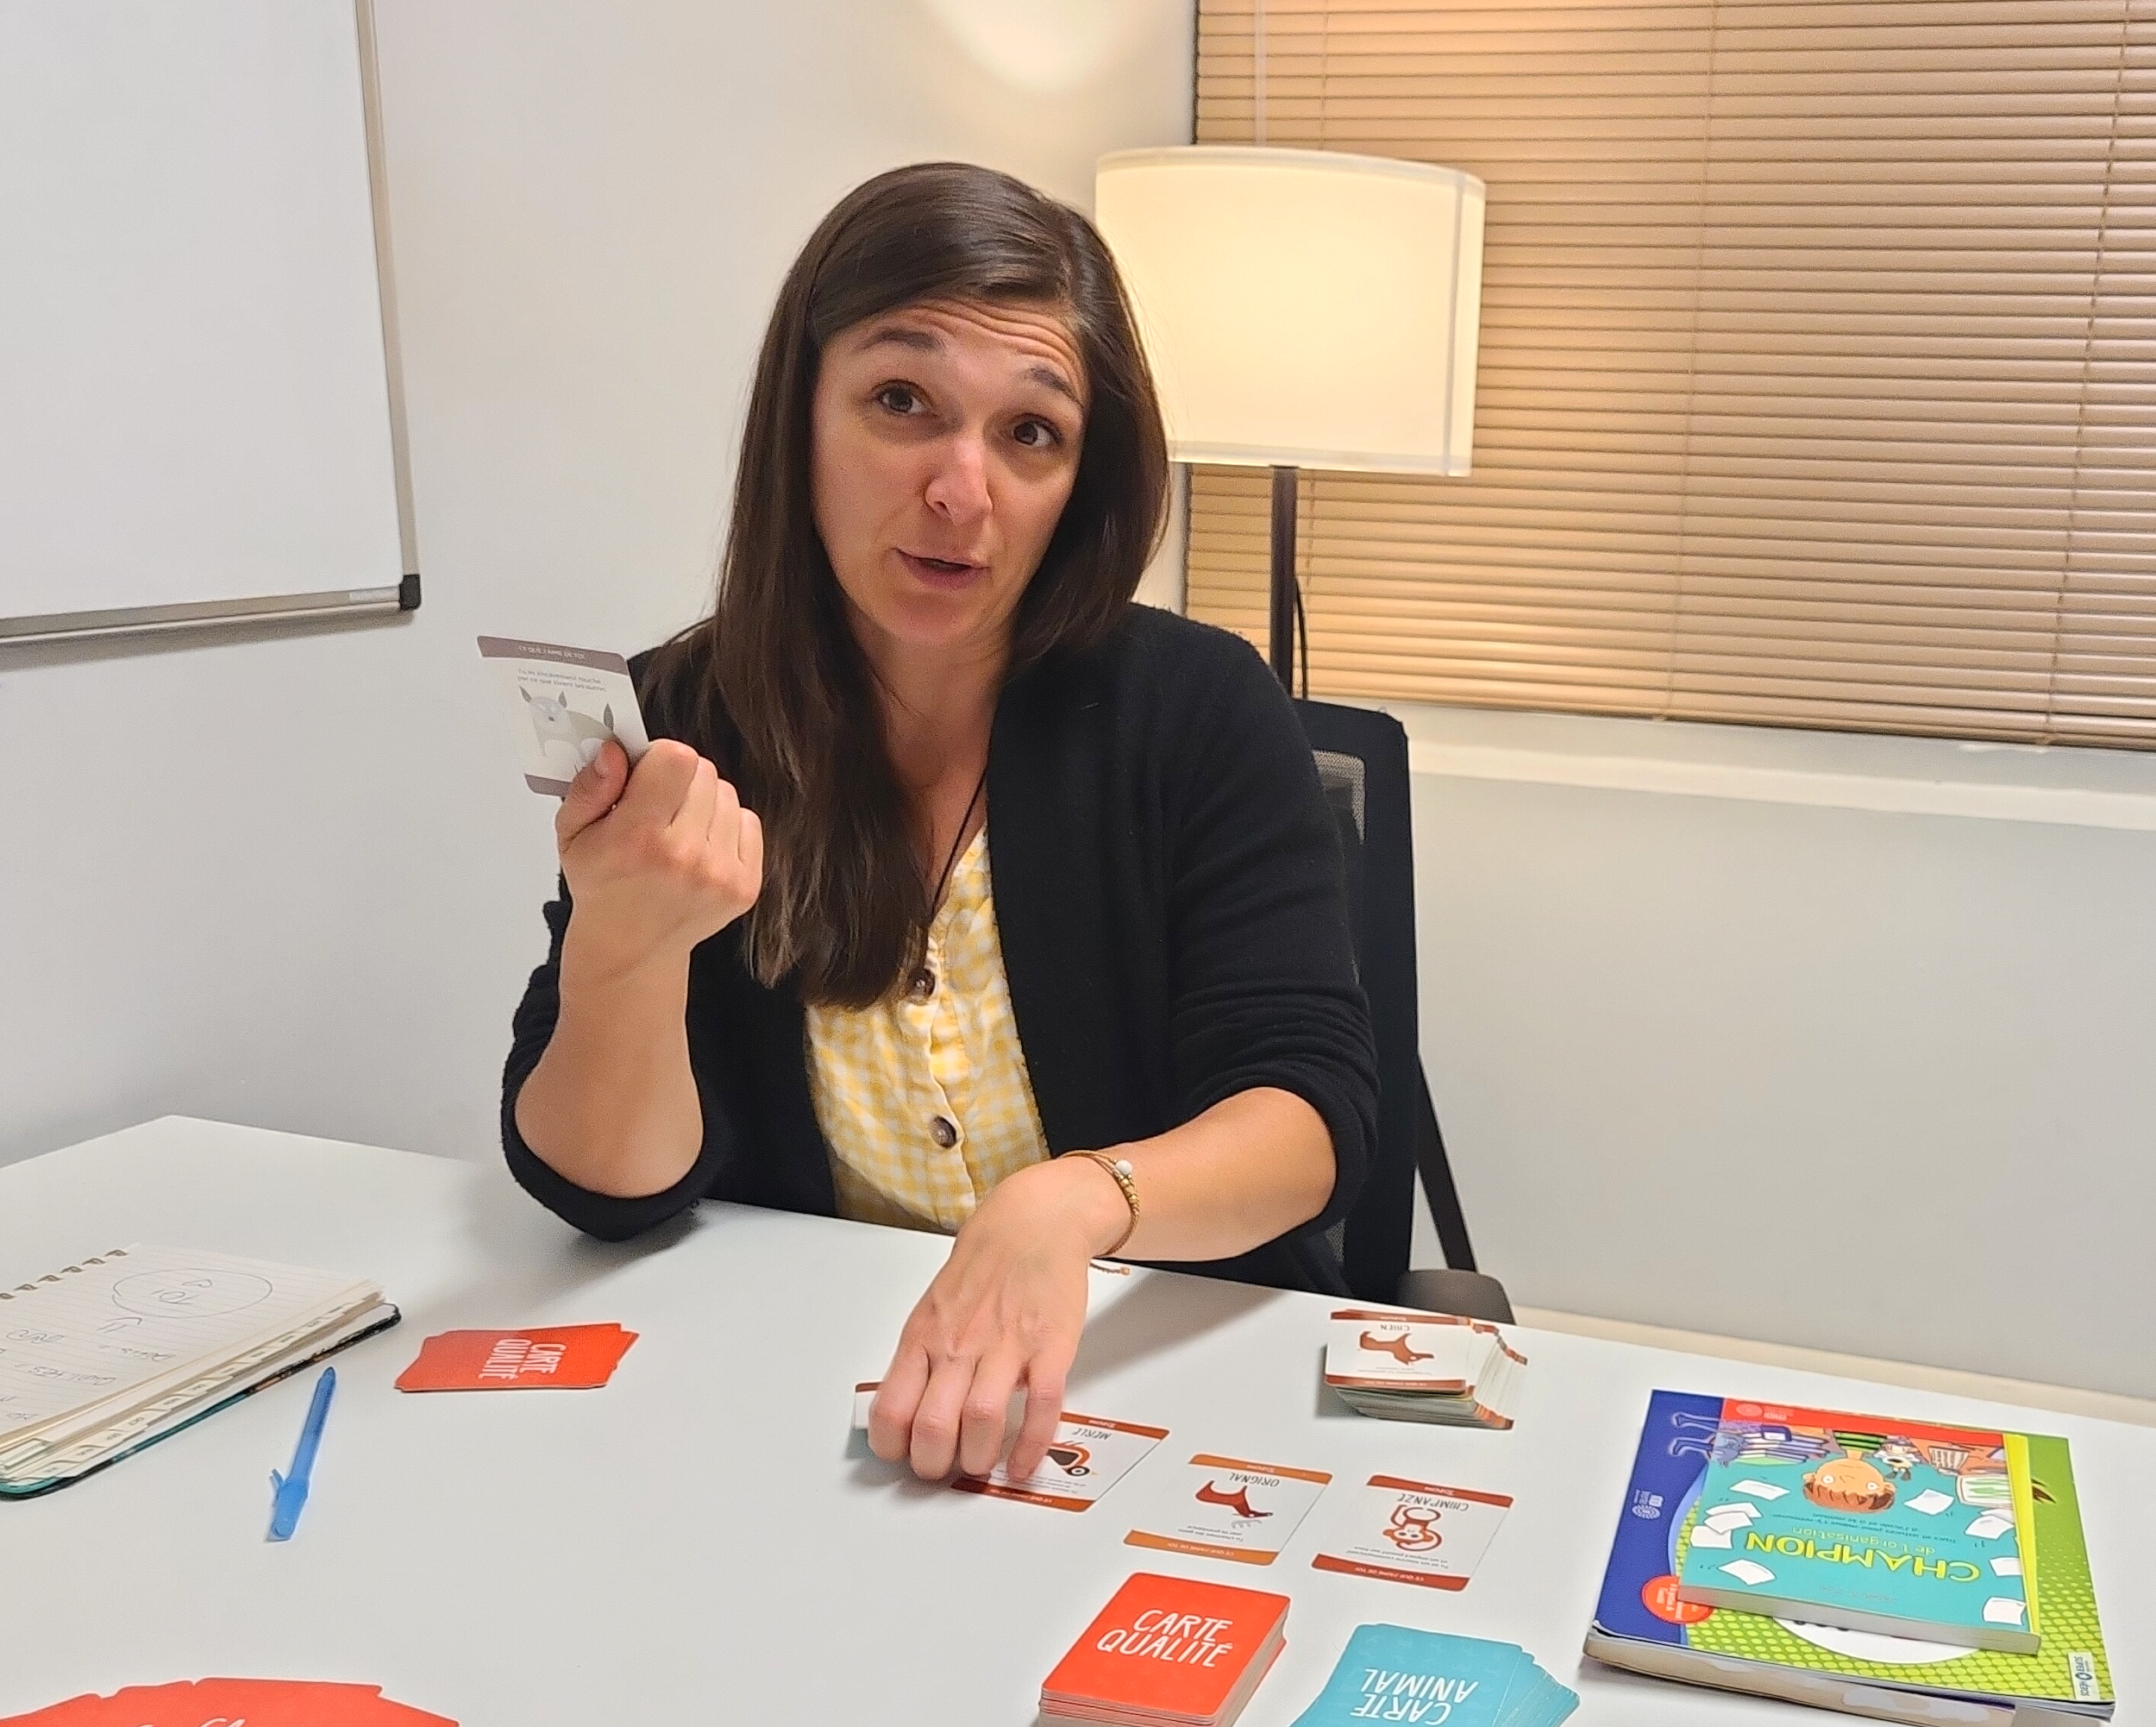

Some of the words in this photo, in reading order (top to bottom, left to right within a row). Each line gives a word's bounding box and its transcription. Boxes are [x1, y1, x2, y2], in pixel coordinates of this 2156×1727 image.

[479, 1339, 532, 1379] QUALITÉ
[518, 1343, 567, 1375] CARTE
[128, 1416, 145, 1427] OCT
[1071, 1427, 1112, 1441] MERLE
[1228, 1472, 1281, 1487] ORIGNAL
[1745, 1530, 1981, 1583] CHAMPION
[1915, 1544, 1935, 1556] de
[1132, 1609, 1234, 1643] CARTE
[1096, 1628, 1234, 1668] QUALITÉ
[1360, 1667, 1480, 1703] ANIMAL
[1350, 1693, 1455, 1726] CARTE
